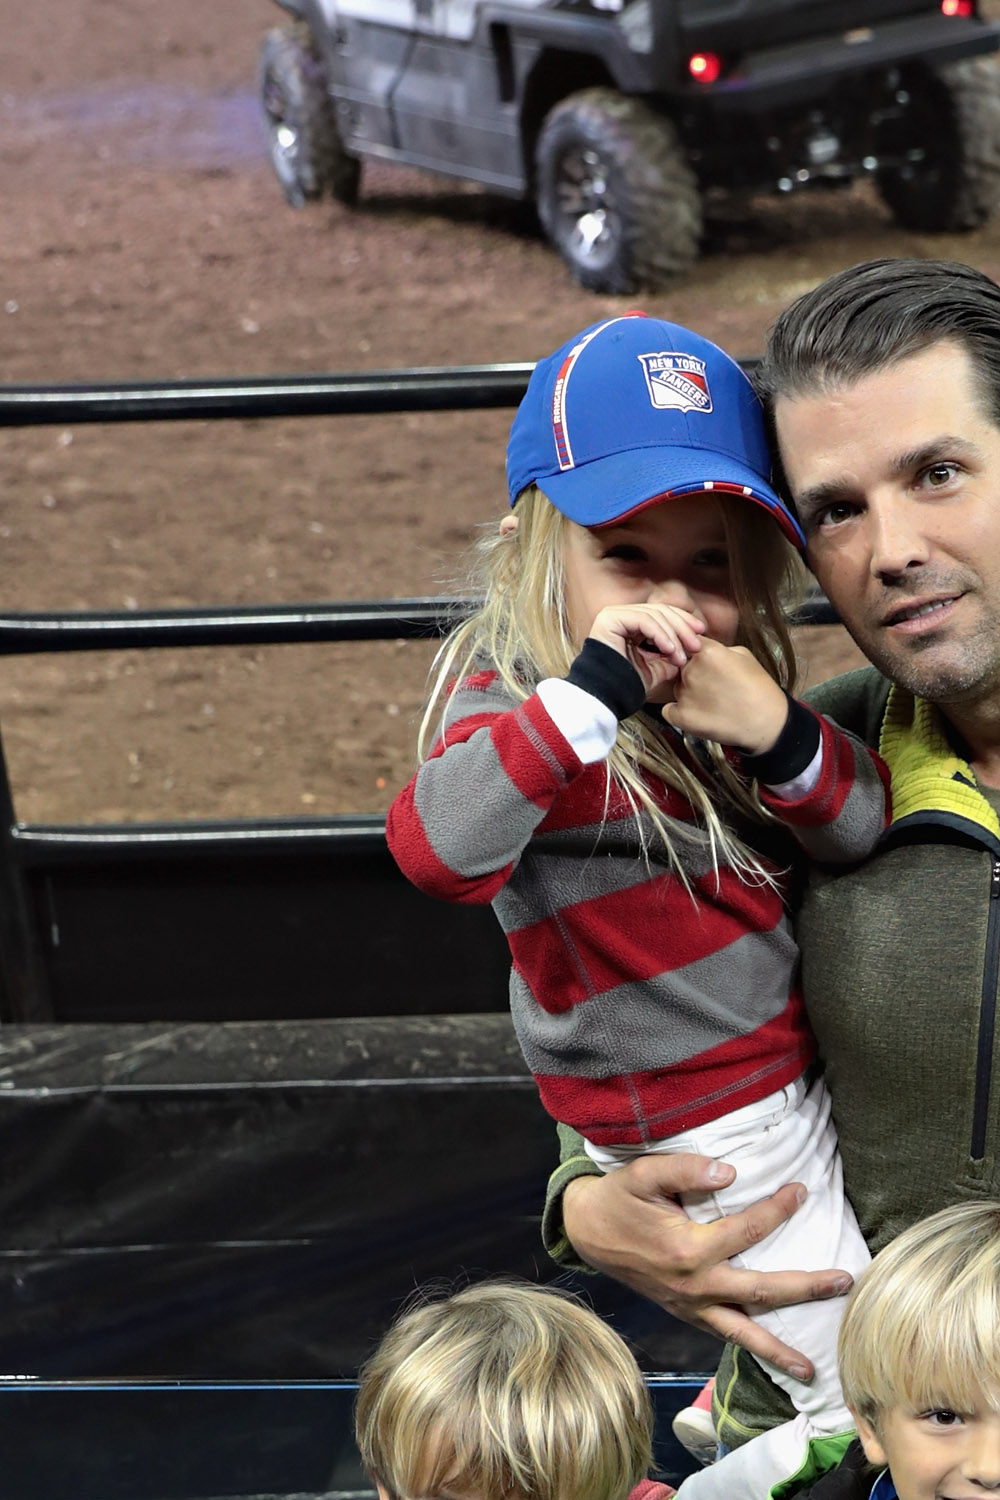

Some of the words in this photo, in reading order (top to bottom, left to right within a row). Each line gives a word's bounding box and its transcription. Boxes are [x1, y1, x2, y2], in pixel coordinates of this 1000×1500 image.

[648, 357, 673, 370] NEW
[674, 357, 703, 374] YORK
[553, 378, 564, 424] RANGERS
[658, 370, 708, 406] RANGERS
